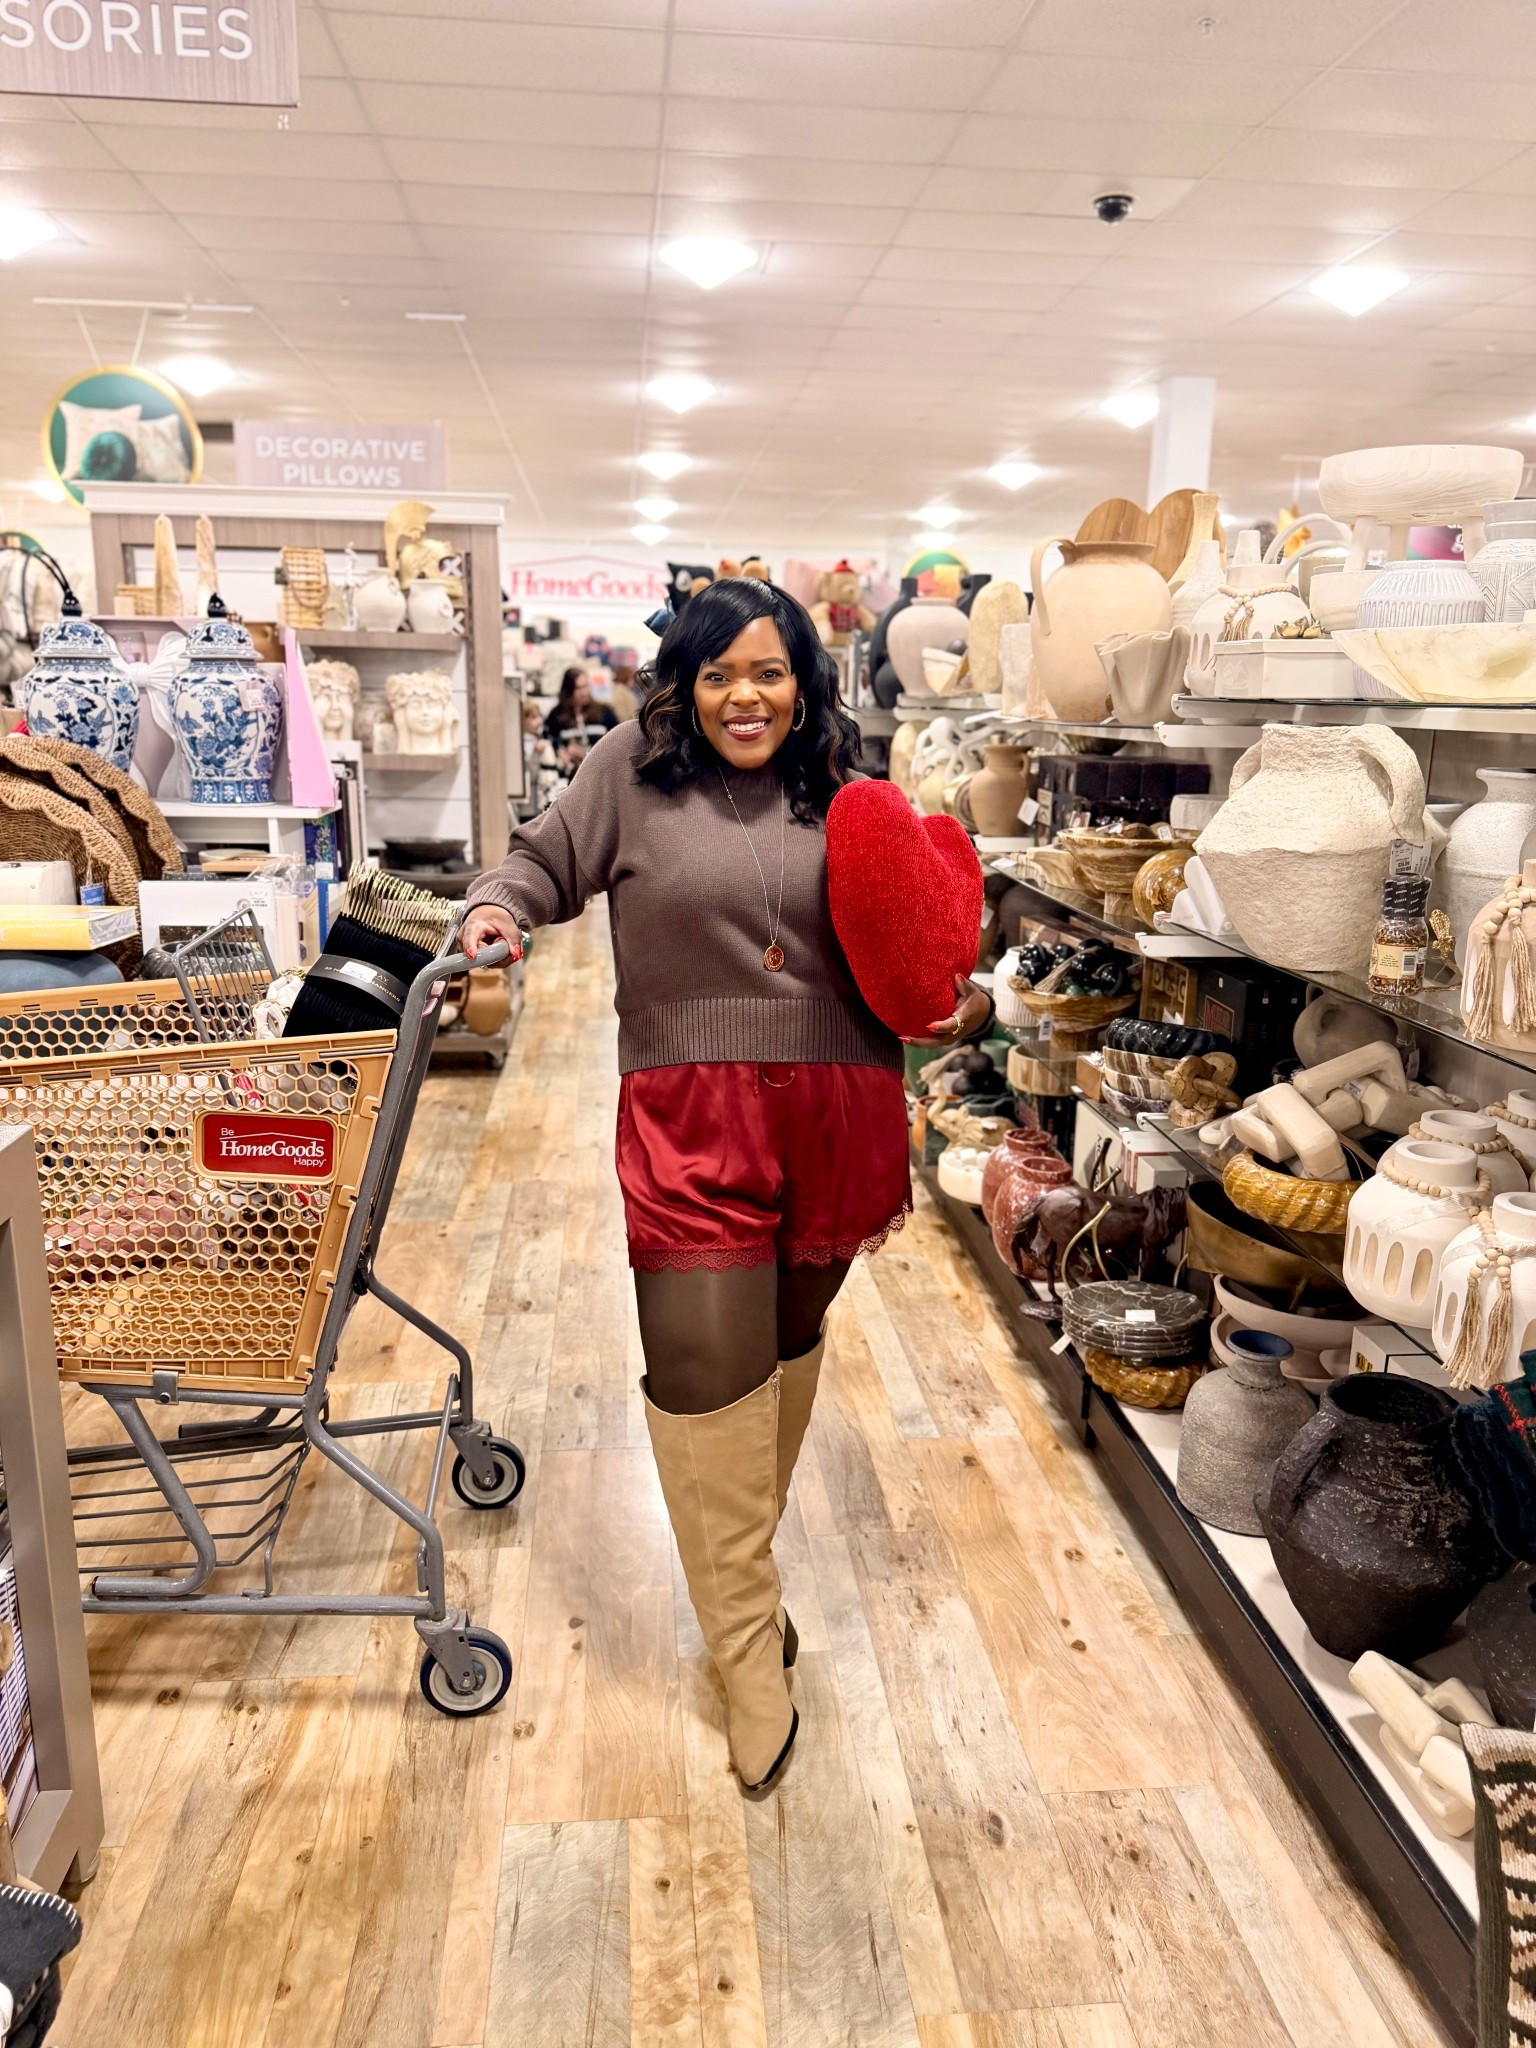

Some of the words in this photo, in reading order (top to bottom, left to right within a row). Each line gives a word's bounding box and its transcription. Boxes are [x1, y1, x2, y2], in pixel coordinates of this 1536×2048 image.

[255, 435, 426, 462] DECORATIVE
[283, 463, 402, 487] PILLOWS
[510, 570, 668, 600] HomeGoods
[221, 1127, 234, 1136] Be
[219, 1140, 325, 1157] HomeGoods
[293, 1157, 325, 1167] Happy
